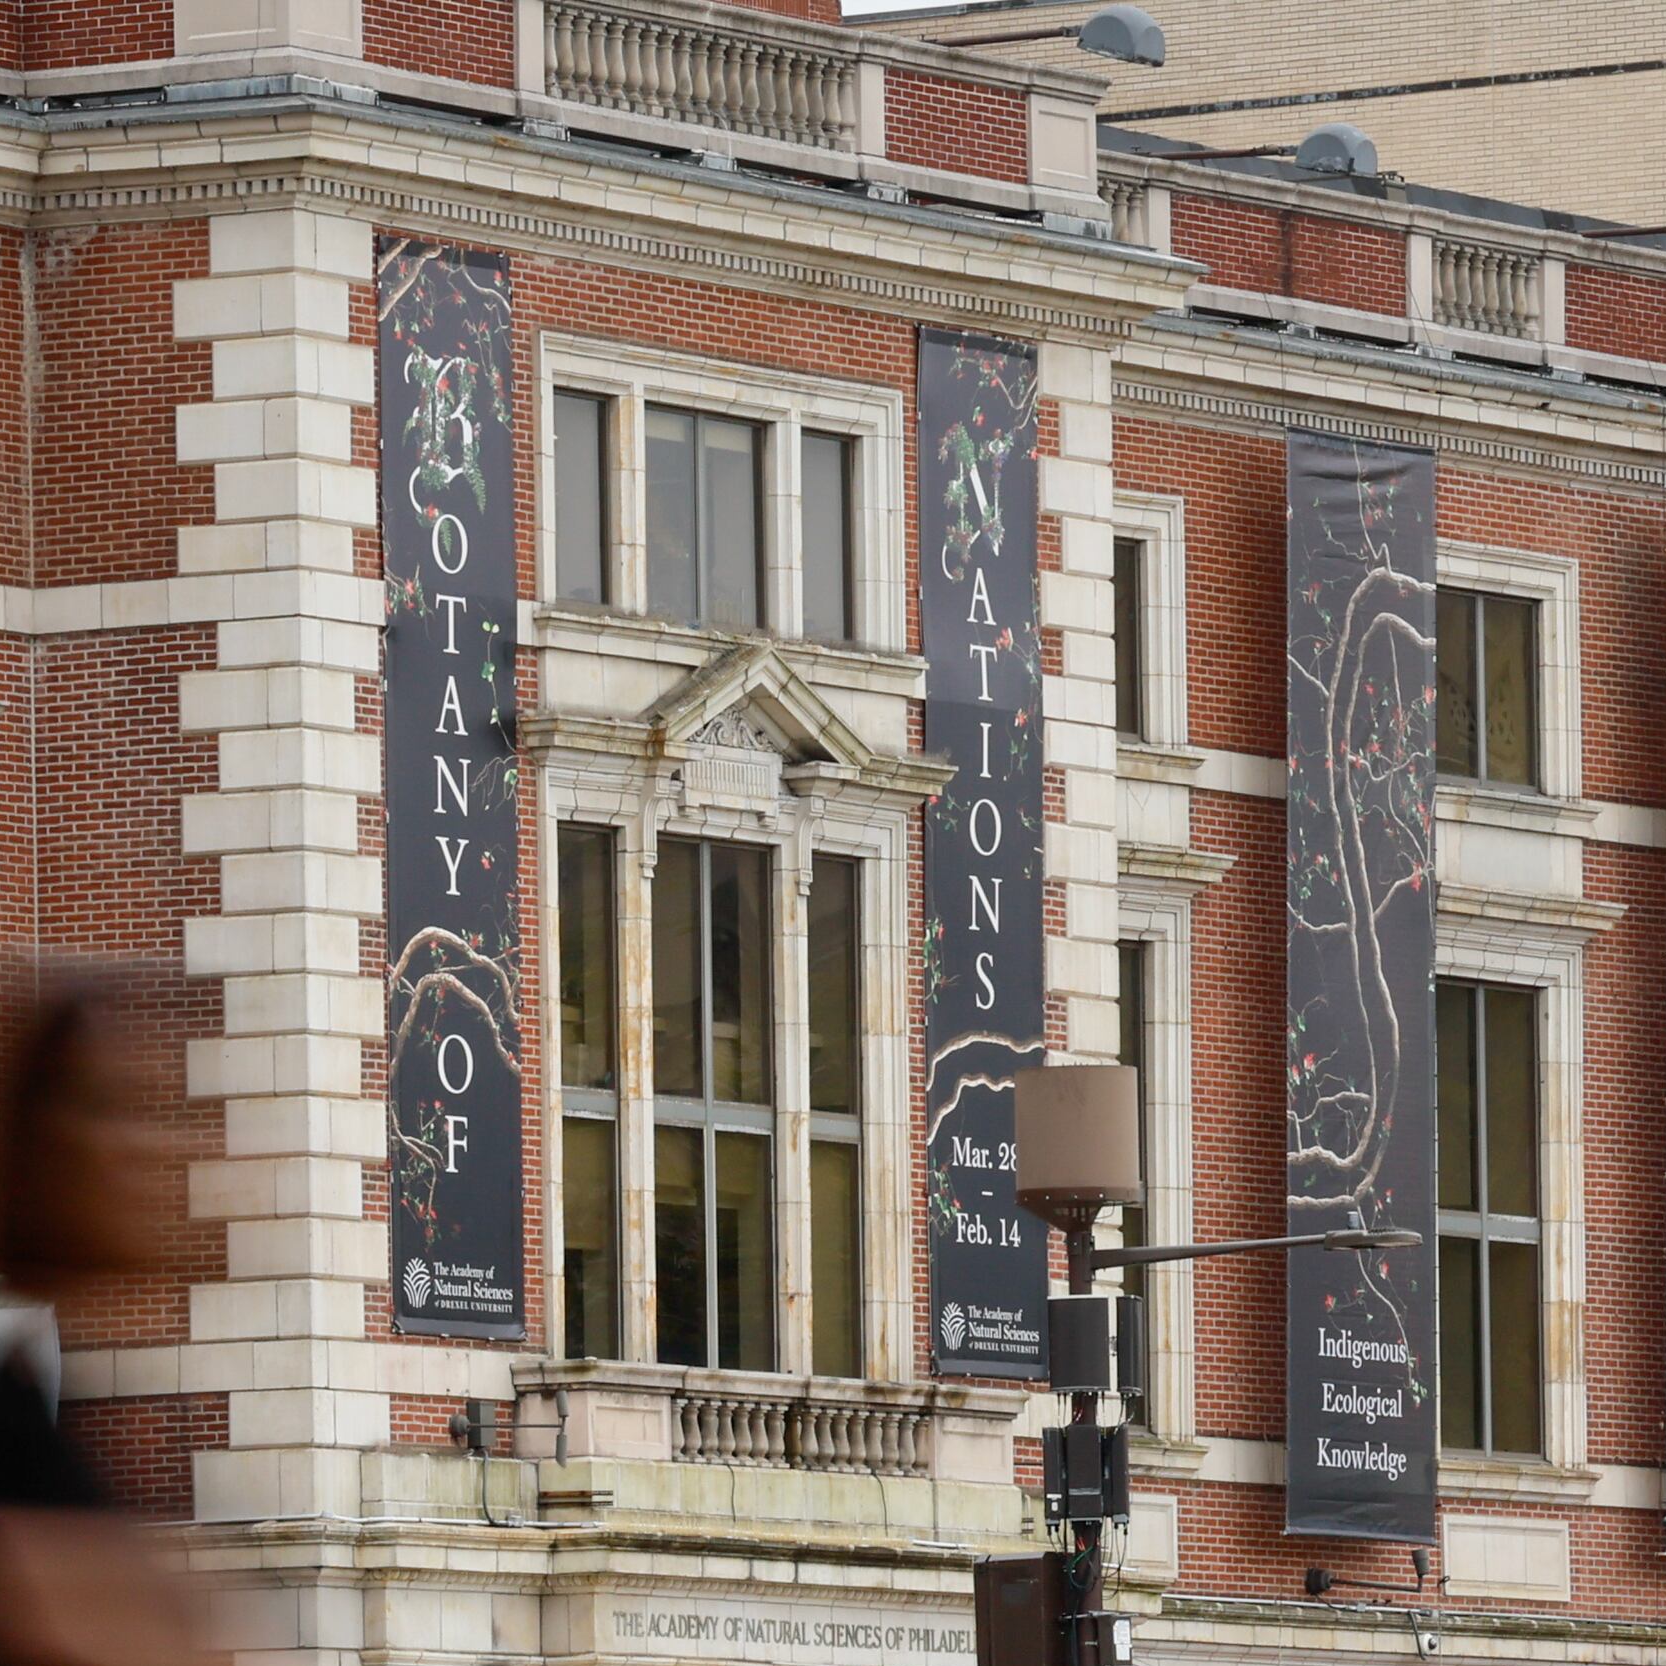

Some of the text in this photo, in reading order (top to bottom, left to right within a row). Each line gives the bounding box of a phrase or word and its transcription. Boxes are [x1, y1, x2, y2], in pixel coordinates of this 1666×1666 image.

[404, 350, 474, 896] BOTANY
[940, 426, 1005, 1010] NATIONS
[438, 1034, 473, 1173] OF
[951, 1136, 993, 1169] Mar.
[955, 1213, 1021, 1248] Feb. 14
[433, 1262, 495, 1281] The Academy of
[434, 1279, 513, 1300] Natural Sciences
[440, 1300, 469, 1310] DREXEL
[470, 1301, 513, 1313] UNIVERSITY
[967, 1305, 1023, 1324] The Academy of
[968, 1321, 1040, 1343] Natural Sciences
[974, 1341, 999, 1351] DREXEL
[1000, 1343, 1039, 1355] UNIVERSITY
[1318, 1328, 1407, 1368] Indigenous
[1321, 1382, 1403, 1424] Ecological
[1317, 1437, 1407, 1481] Knowledge
[613, 1610, 978, 1654] THE ACADEMY OF NATURAL SCIENCES OF PHILADEL
